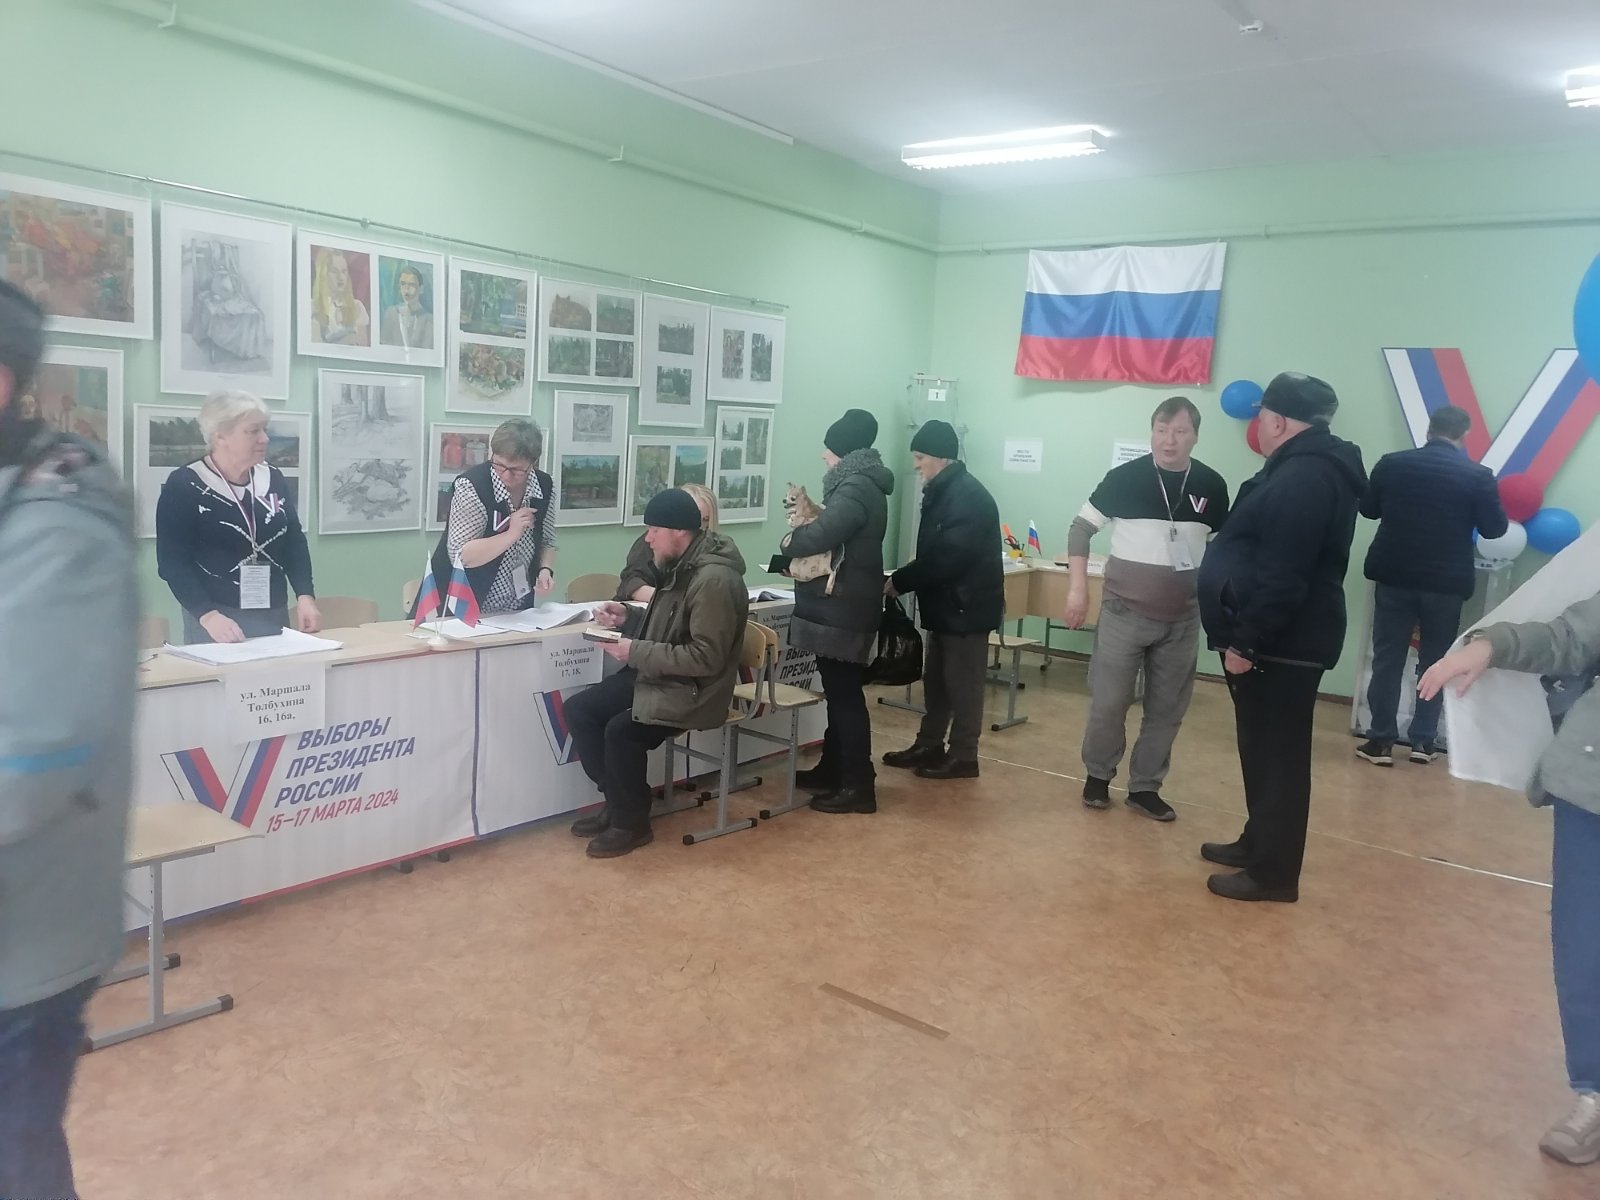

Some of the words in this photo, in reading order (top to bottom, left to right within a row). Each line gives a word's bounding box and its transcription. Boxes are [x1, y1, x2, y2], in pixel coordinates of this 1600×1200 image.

[562, 647, 595, 656] Маршала
[555, 658, 590, 668] Толбухина
[780, 660, 818, 680] ПРЕЗИД
[240, 691, 257, 703] ул.
[260, 683, 311, 697] Маршала
[247, 697, 305, 713] Толбухина
[297, 716, 392, 751] ВЫБОРЫ
[285, 736, 416, 780] ПРЕЗИДЕНТА
[274, 772, 363, 809] РОССИИ
[311, 796, 362, 823] МАРТА
[364, 788, 399, 811] 2024
